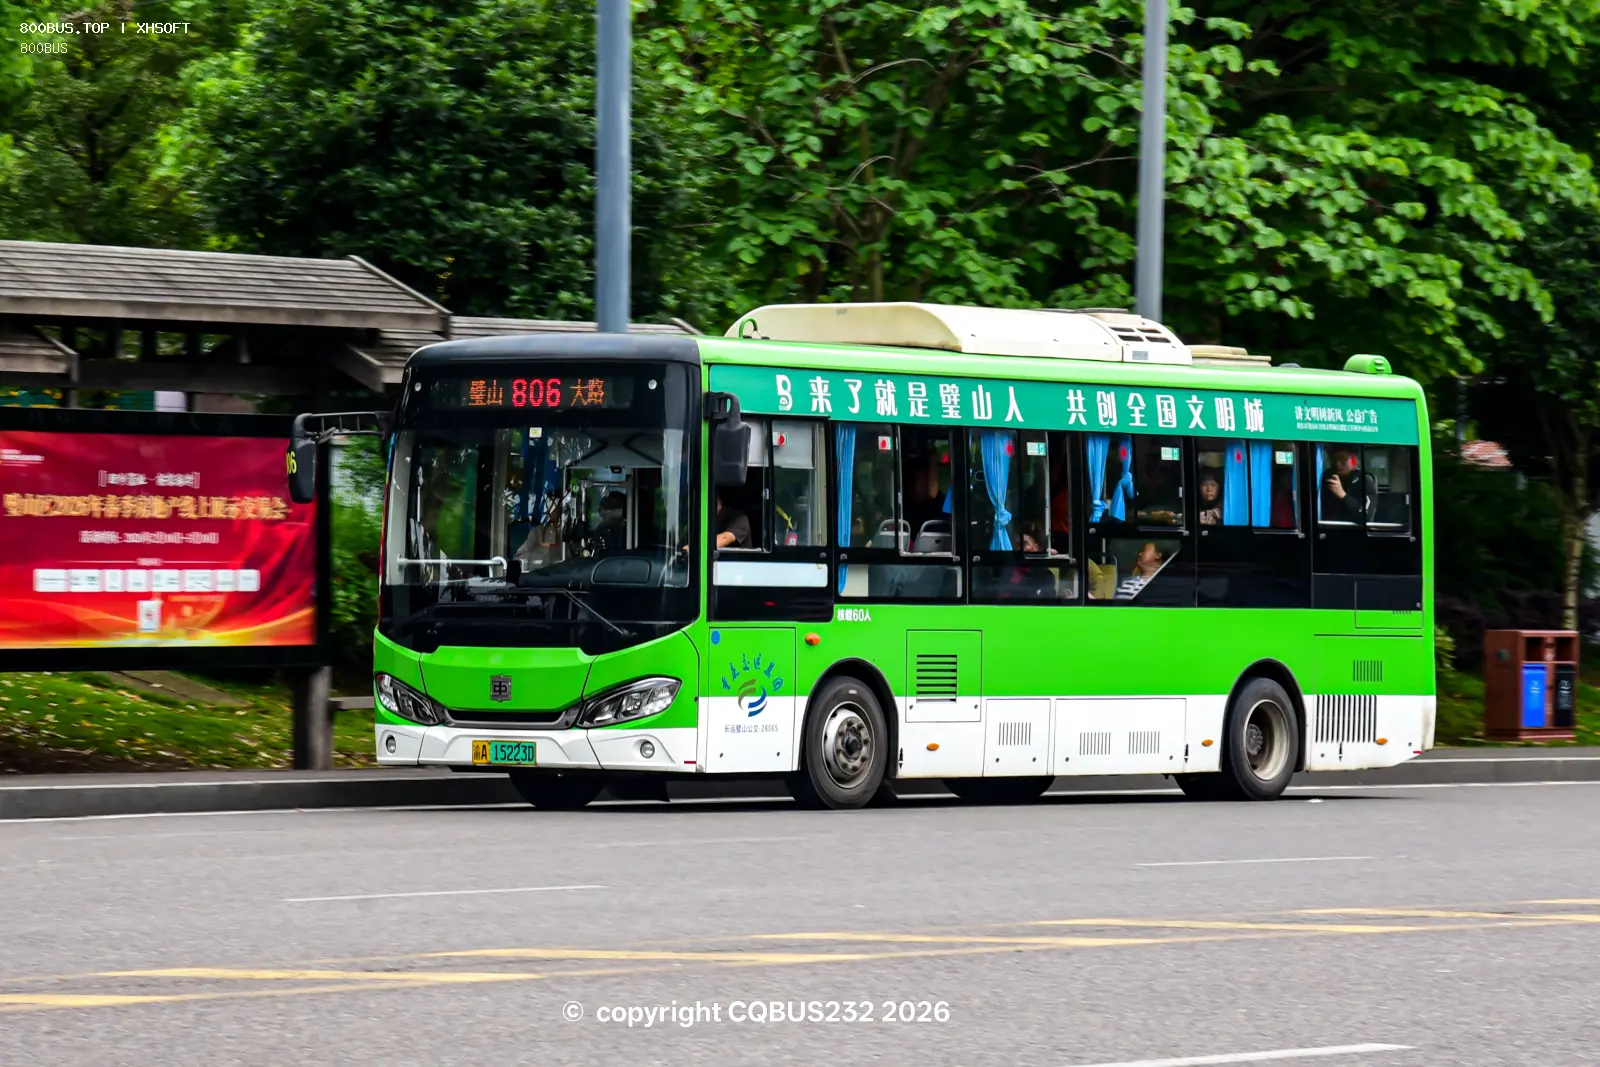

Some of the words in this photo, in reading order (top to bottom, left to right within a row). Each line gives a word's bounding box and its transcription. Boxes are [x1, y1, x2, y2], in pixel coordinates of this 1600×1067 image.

[468, 379, 503, 406] 璧山
[511, 378, 561, 407] 806
[569, 378, 605, 407] 大路
[808, 375, 1025, 423] 来了就是璧山人
[1065, 388, 1265, 433] 共创全国文明城
[1346, 408, 1378, 425] 公益广告
